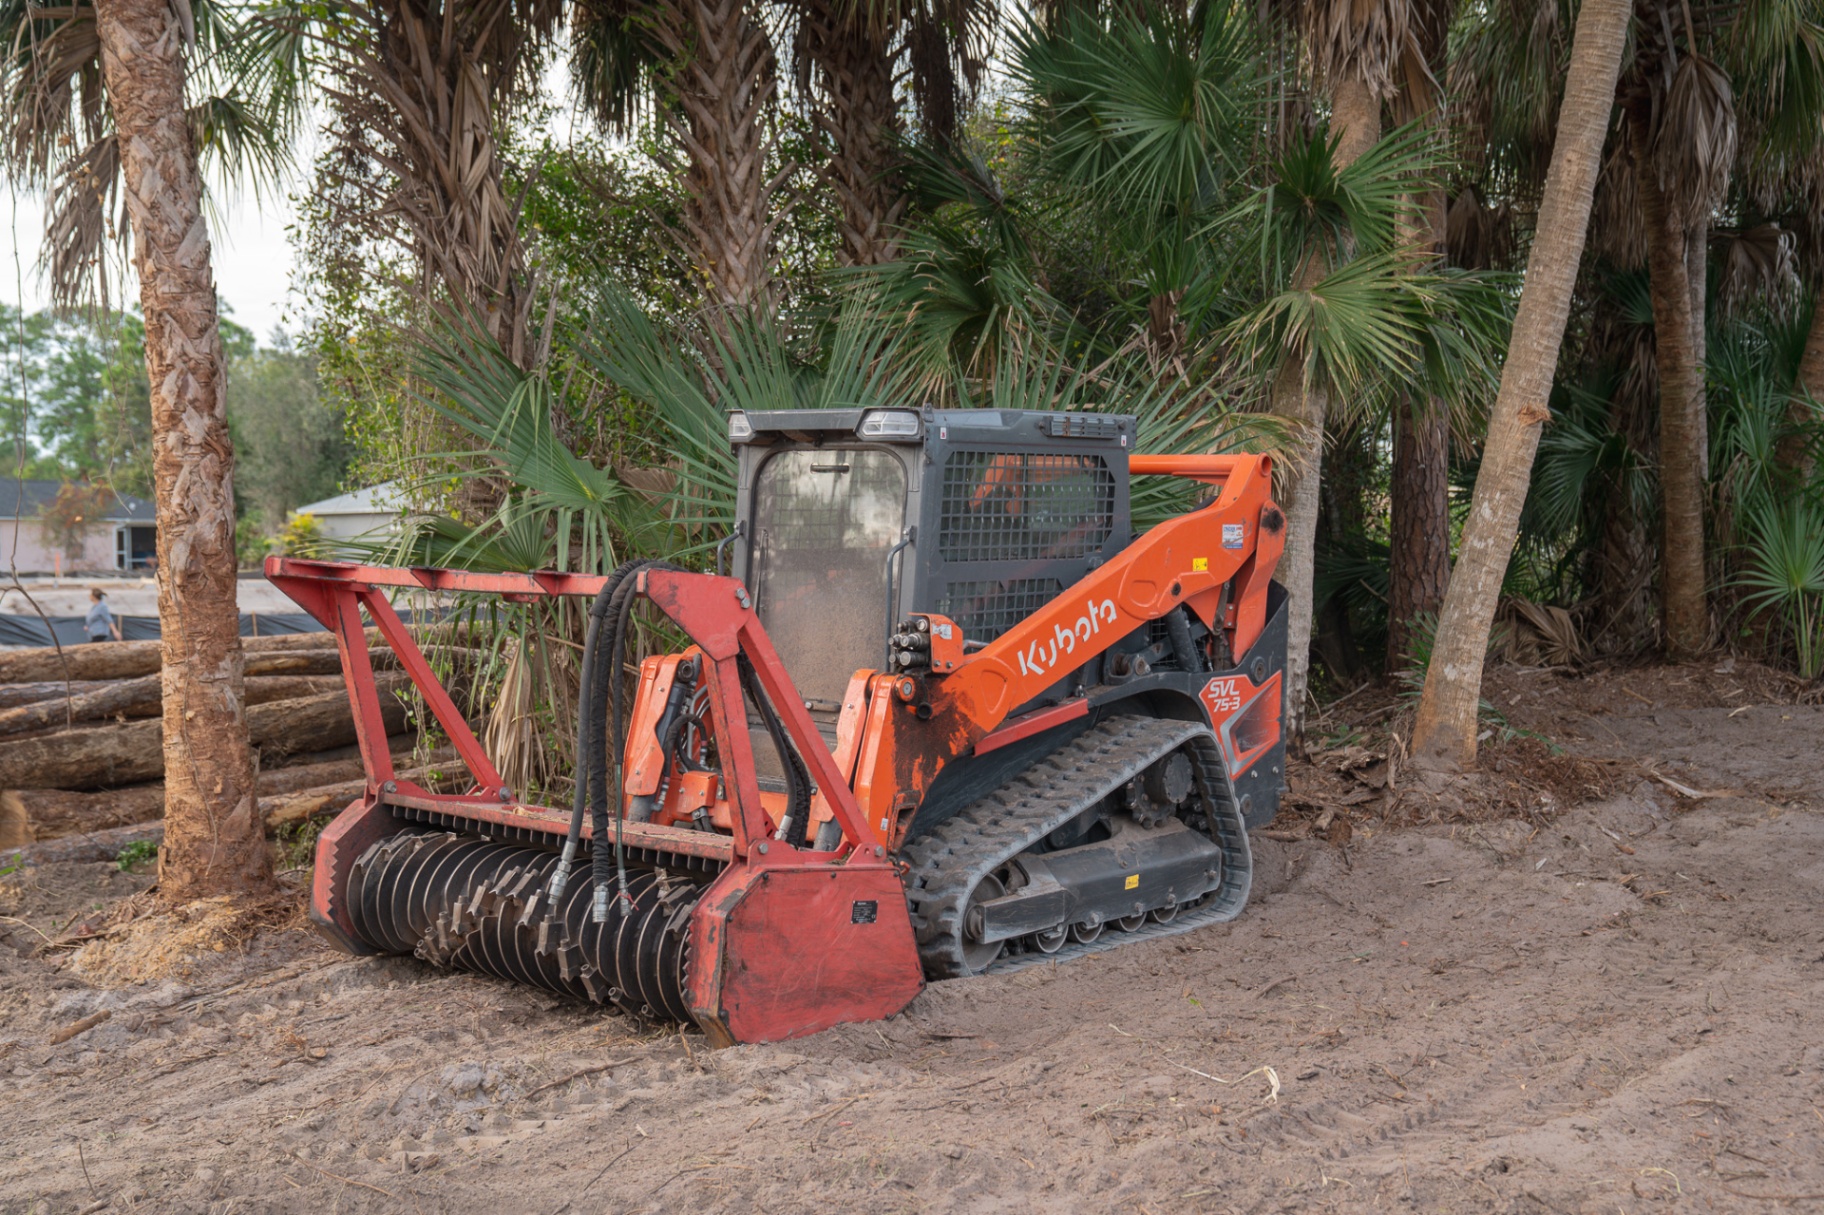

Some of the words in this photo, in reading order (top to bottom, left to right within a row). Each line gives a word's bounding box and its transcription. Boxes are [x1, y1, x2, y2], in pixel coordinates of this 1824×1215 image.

[1017, 599, 1117, 677] Kubota
[1208, 680, 1240, 698] SVL
[1213, 697, 1241, 713] 75-3
